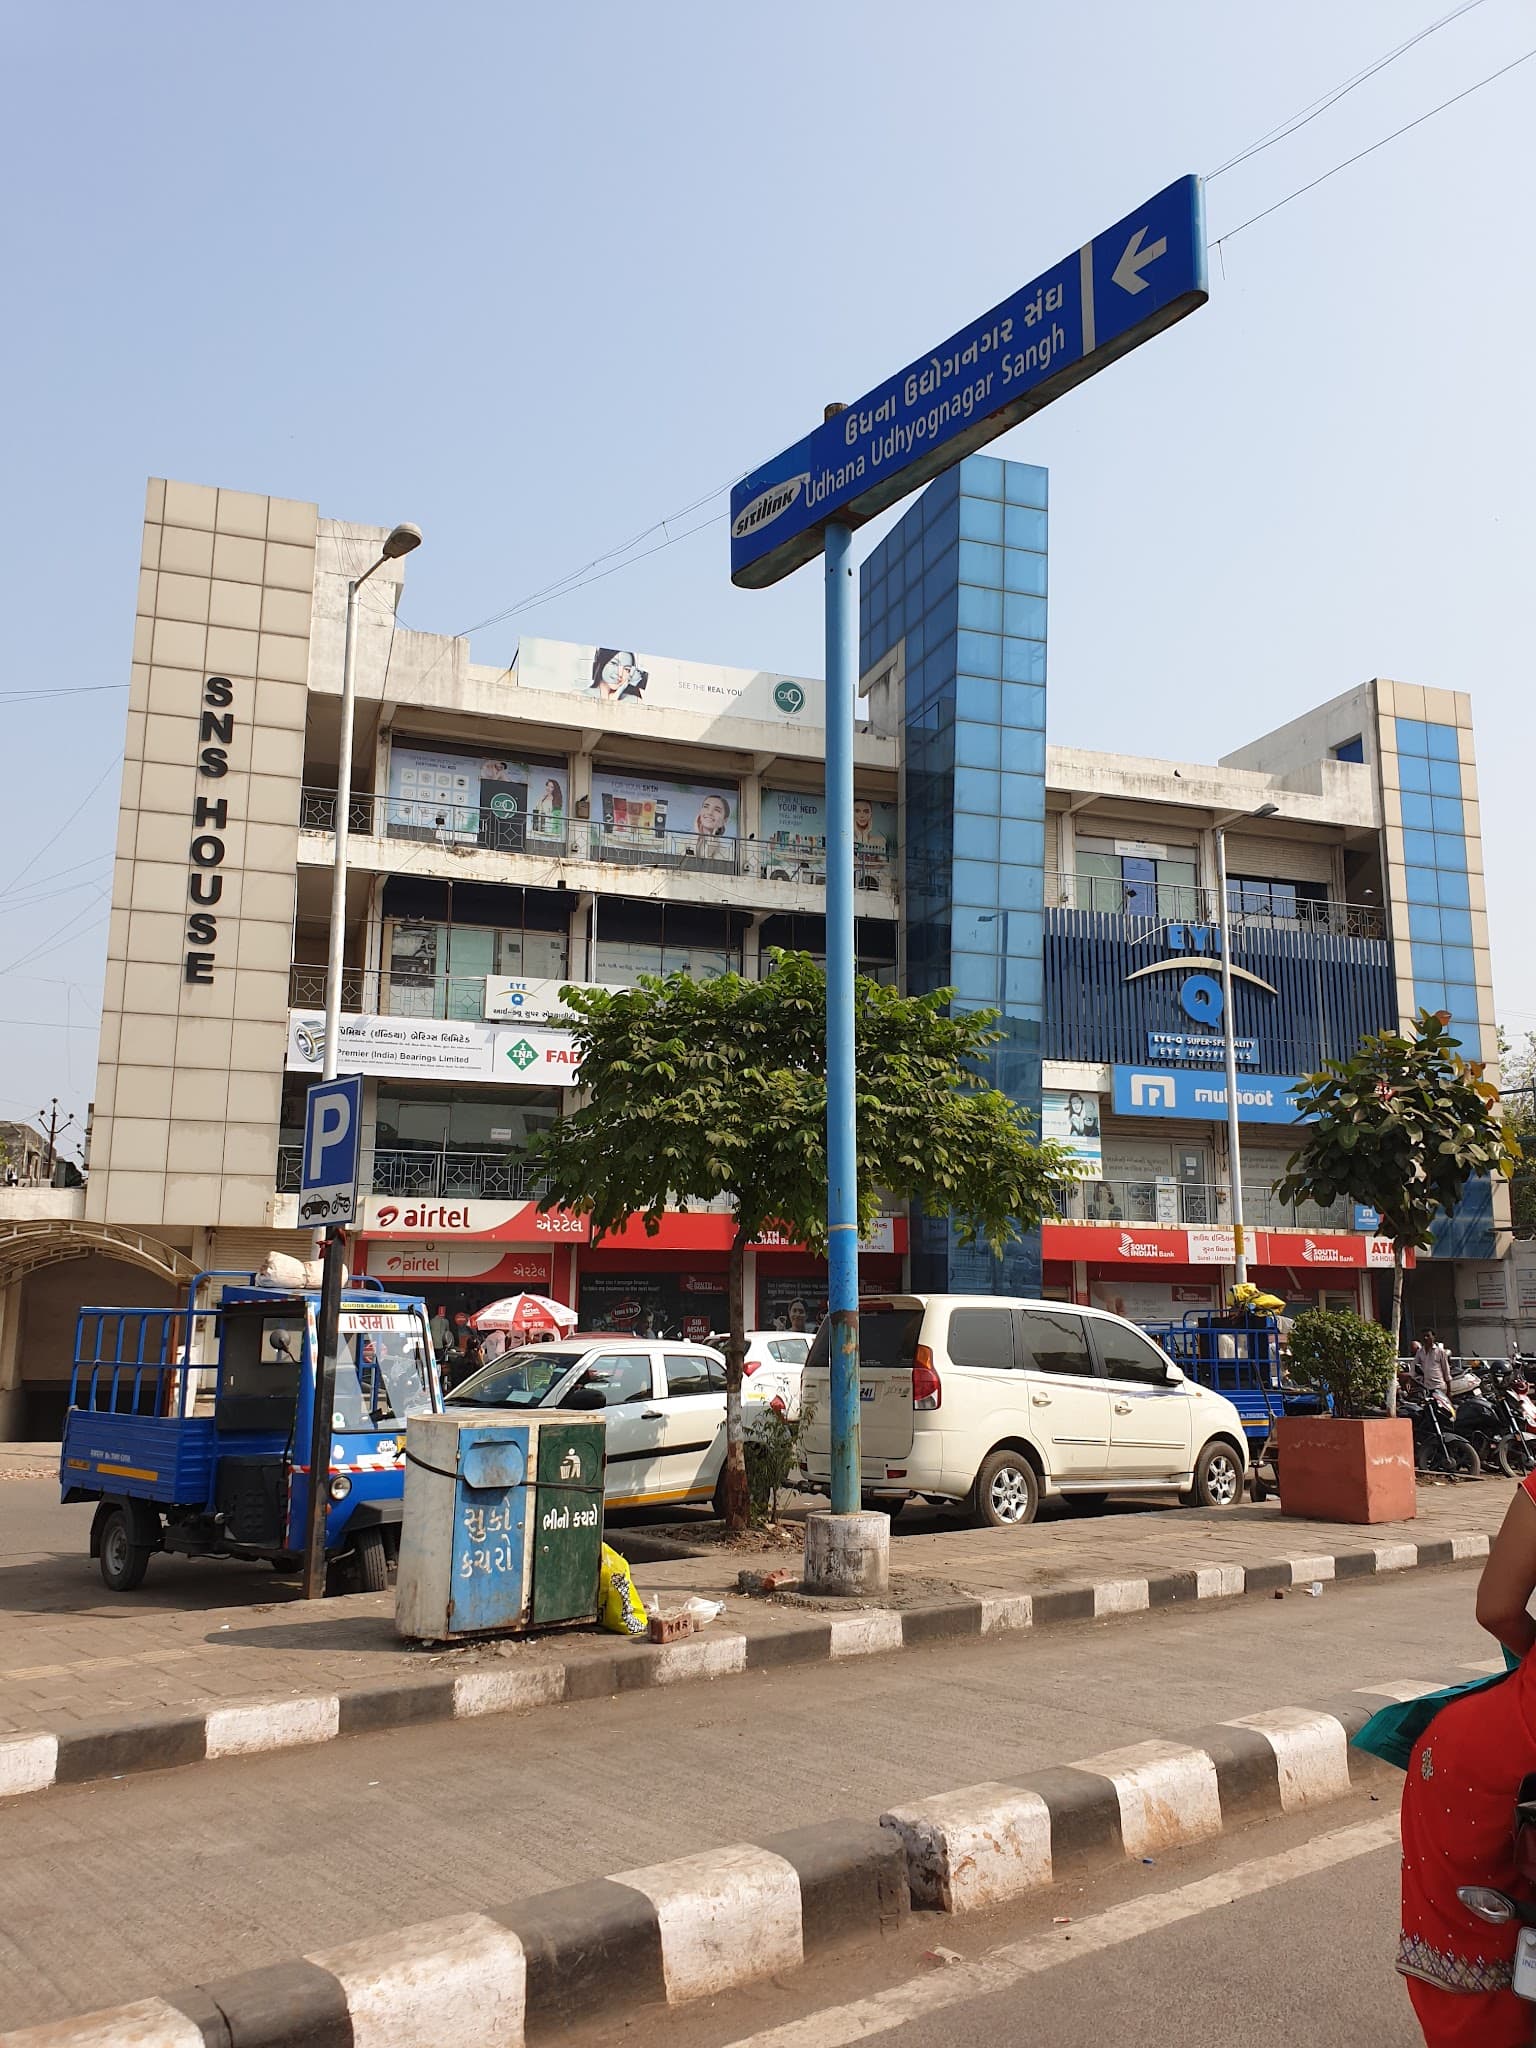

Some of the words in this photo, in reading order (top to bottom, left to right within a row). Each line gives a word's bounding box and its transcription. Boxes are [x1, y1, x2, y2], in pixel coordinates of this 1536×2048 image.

[845, 395, 896, 446] ઉધના
[1024, 282, 1064, 328] સંઘ
[804, 455, 865, 509] Udhana
[871, 371, 994, 467] Udhyognagar
[1001, 322, 1065, 385] Sangh
[678, 681, 691, 690] SEE
[693, 683, 705, 692] THE
[707, 685, 725, 695] REAL
[726, 687, 743, 697] YOU
[199, 676, 234, 779] SNS
[778, 802, 797, 812] YOUR
[800, 805, 818, 815] NEED
[185, 796, 228, 985] HOUSE
[510, 982, 527, 990] EYE
[1181, 974, 1224, 1029] Q
[1154, 1034, 1183, 1044] EYE-Q
[337, 1048, 368, 1058] Premier
[371, 1050, 398, 1061] (India)
[400, 1052, 436, 1063] Bearings
[439, 1053, 469, 1064] Limited
[1160, 1047, 1181, 1056] EYE
[309, 1093, 351, 1181] P
[403, 1203, 470, 1228] airtel
[536, 1212, 583, 1233] એરટેલ
[1130, 1243, 1158, 1251] SOUTH
[1158, 1250, 1175, 1258] Bank
[403, 1257, 440, 1271] airtel
[1339, 1255, 1354, 1263] Bank
[513, 1263, 546, 1278] એરટેલ
[359, 1315, 383, 1330] राम
[543, 1506, 570, 1530] ભીનો
[573, 1504, 598, 1527] કચરો
[461, 1533, 513, 1578] કચરો
